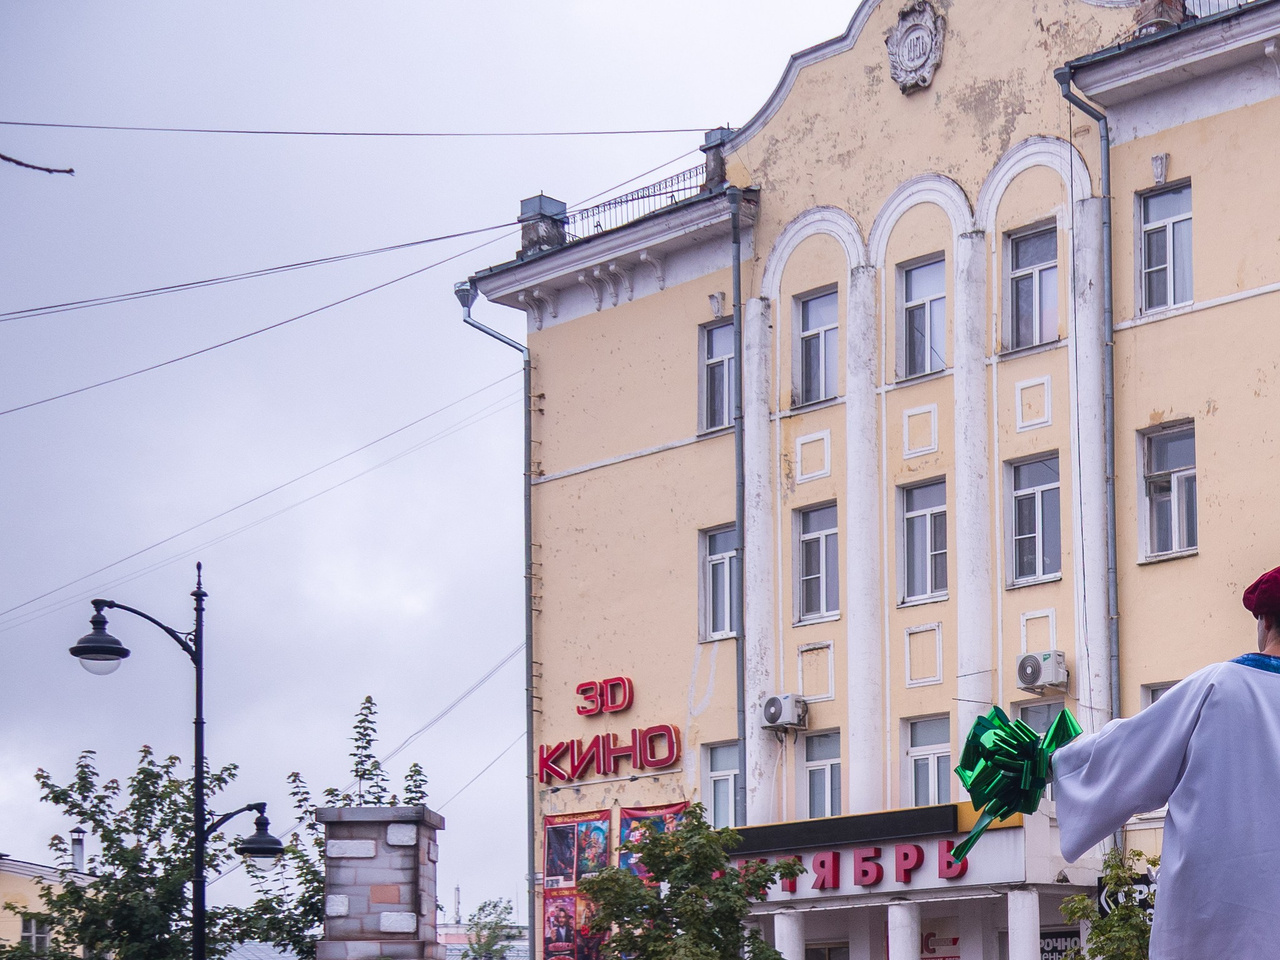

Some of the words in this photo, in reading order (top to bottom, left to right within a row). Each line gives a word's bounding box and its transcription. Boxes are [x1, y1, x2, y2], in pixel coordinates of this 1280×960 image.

[576, 676, 634, 716] 3D
[539, 724, 681, 784] КИНО
[1040, 937, 1080, 951] РОЧНО
